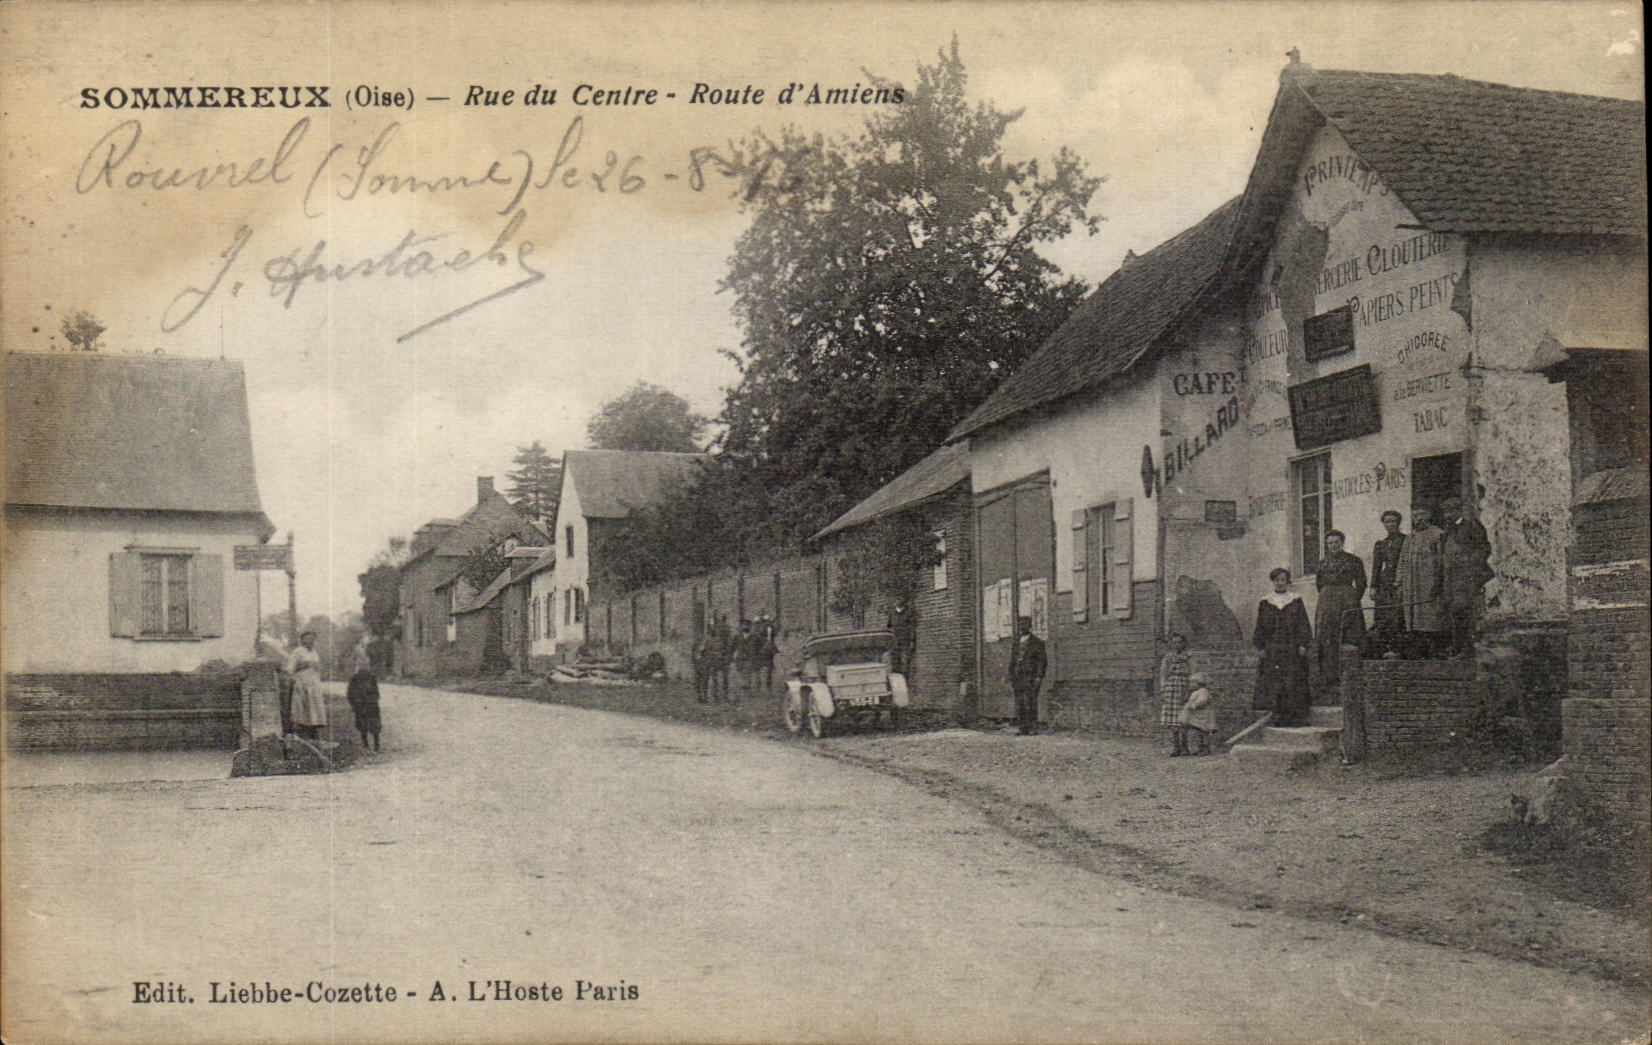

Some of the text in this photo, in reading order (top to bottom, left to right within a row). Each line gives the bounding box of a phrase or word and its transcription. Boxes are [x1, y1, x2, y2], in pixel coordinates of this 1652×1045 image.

[75, 116, 310, 195] Rouvrel
[303, 121, 534, 219] (Somme)
[1367, 232, 1450, 275] CLOUTERIE
[1346, 272, 1459, 327] PAPIERS PEINTS
[1163, 396, 1239, 485] BILLARD
[1413, 406, 1448, 433] TABAC
